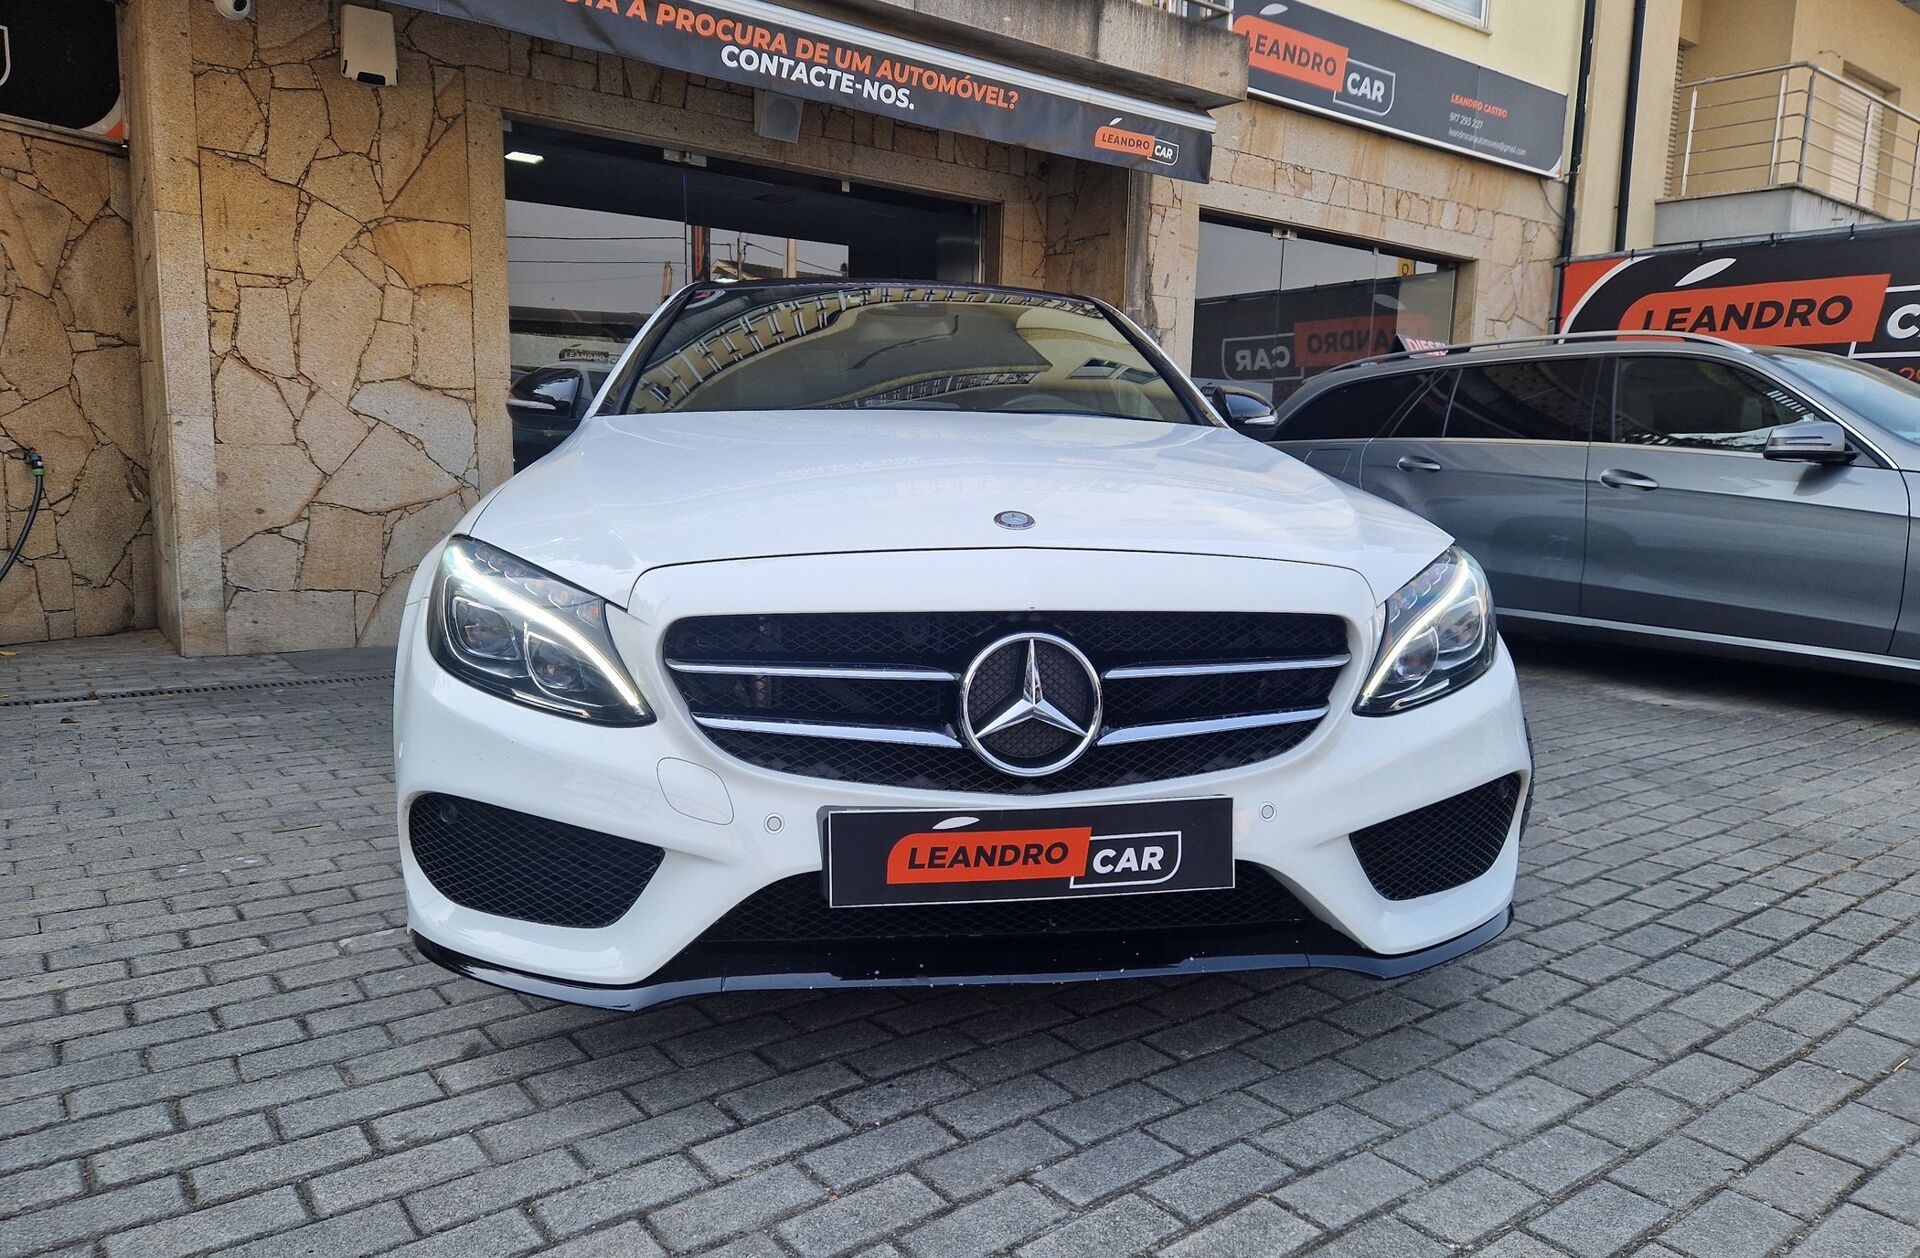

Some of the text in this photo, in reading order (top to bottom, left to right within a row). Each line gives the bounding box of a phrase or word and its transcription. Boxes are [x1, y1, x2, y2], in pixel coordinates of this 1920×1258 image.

[656, 3, 788, 55] PROCURA
[796, 38, 830, 65] DE
[835, 47, 872, 75] UM
[876, 59, 1019, 110] AUTOMÓVEL?
[721, 45, 915, 111] CONTACTE-NOS.
[1347, 72, 1385, 103] CAR
[1451, 93, 1508, 118] LEANDRO CASTRO
[1101, 132, 1173, 159] LEANDRO CAR
[1642, 295, 1920, 340] LEANDRO C
[564, 351, 605, 360] LEANDRO
[907, 841, 1164, 874] LEANDRO CAR
